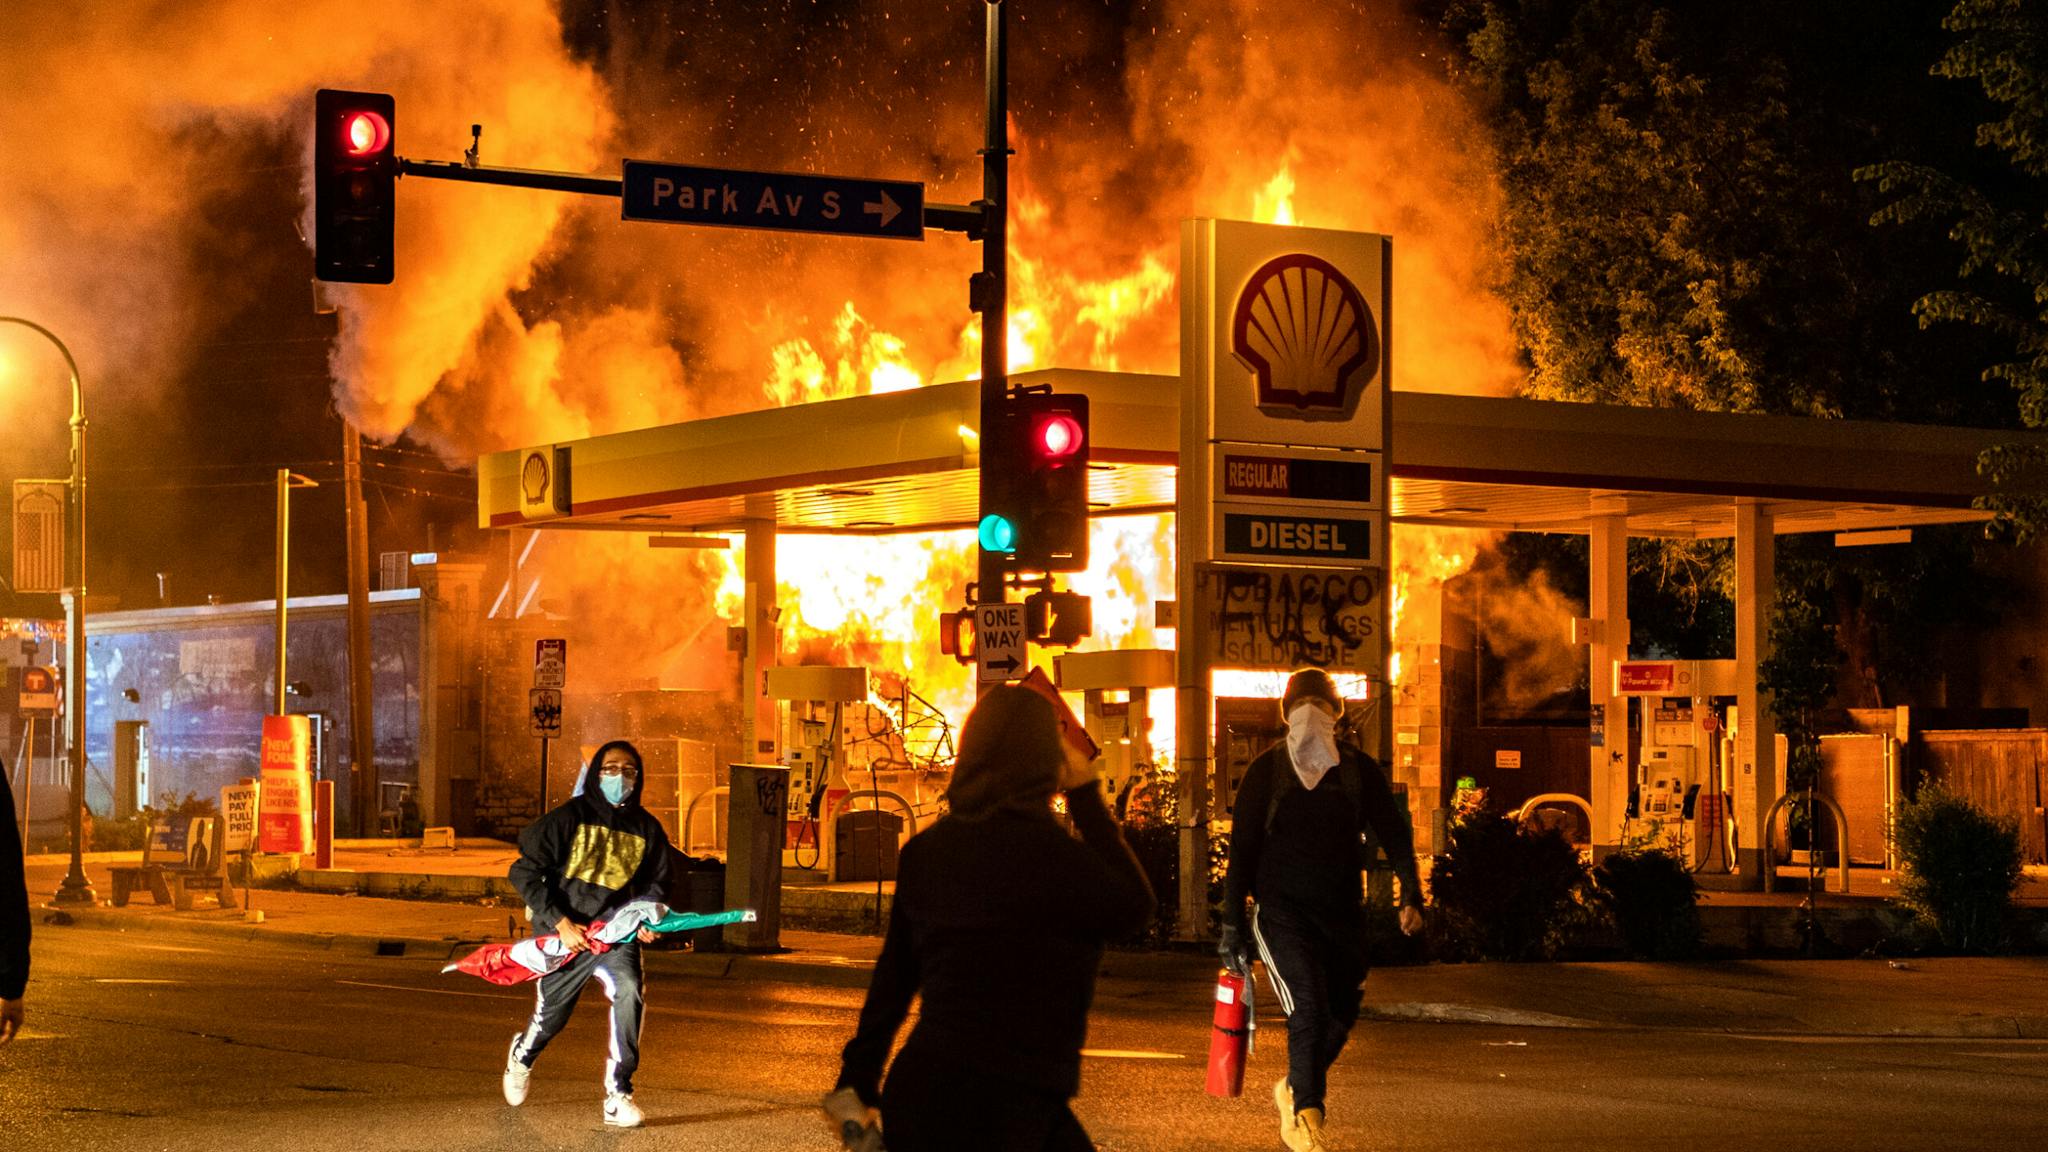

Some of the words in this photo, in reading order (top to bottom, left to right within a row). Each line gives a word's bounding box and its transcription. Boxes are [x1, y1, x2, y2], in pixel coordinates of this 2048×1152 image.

[653, 177, 739, 215] Park
[756, 186, 803, 217] Av
[821, 191, 841, 219] S
[1229, 462, 1288, 489] REGULAR
[1250, 521, 1346, 551] DIESEL
[1209, 570, 1373, 606] TOBACCO
[983, 609, 1020, 627] ONE
[1319, 615, 1373, 636] CGS
[984, 630, 1021, 649] WAY
[1227, 642, 1285, 664] SOLD
[27, 673, 45, 690] T
[267, 739, 290, 750] NEW
[229, 801, 247, 811] PAY
[229, 812, 252, 822] FULL
